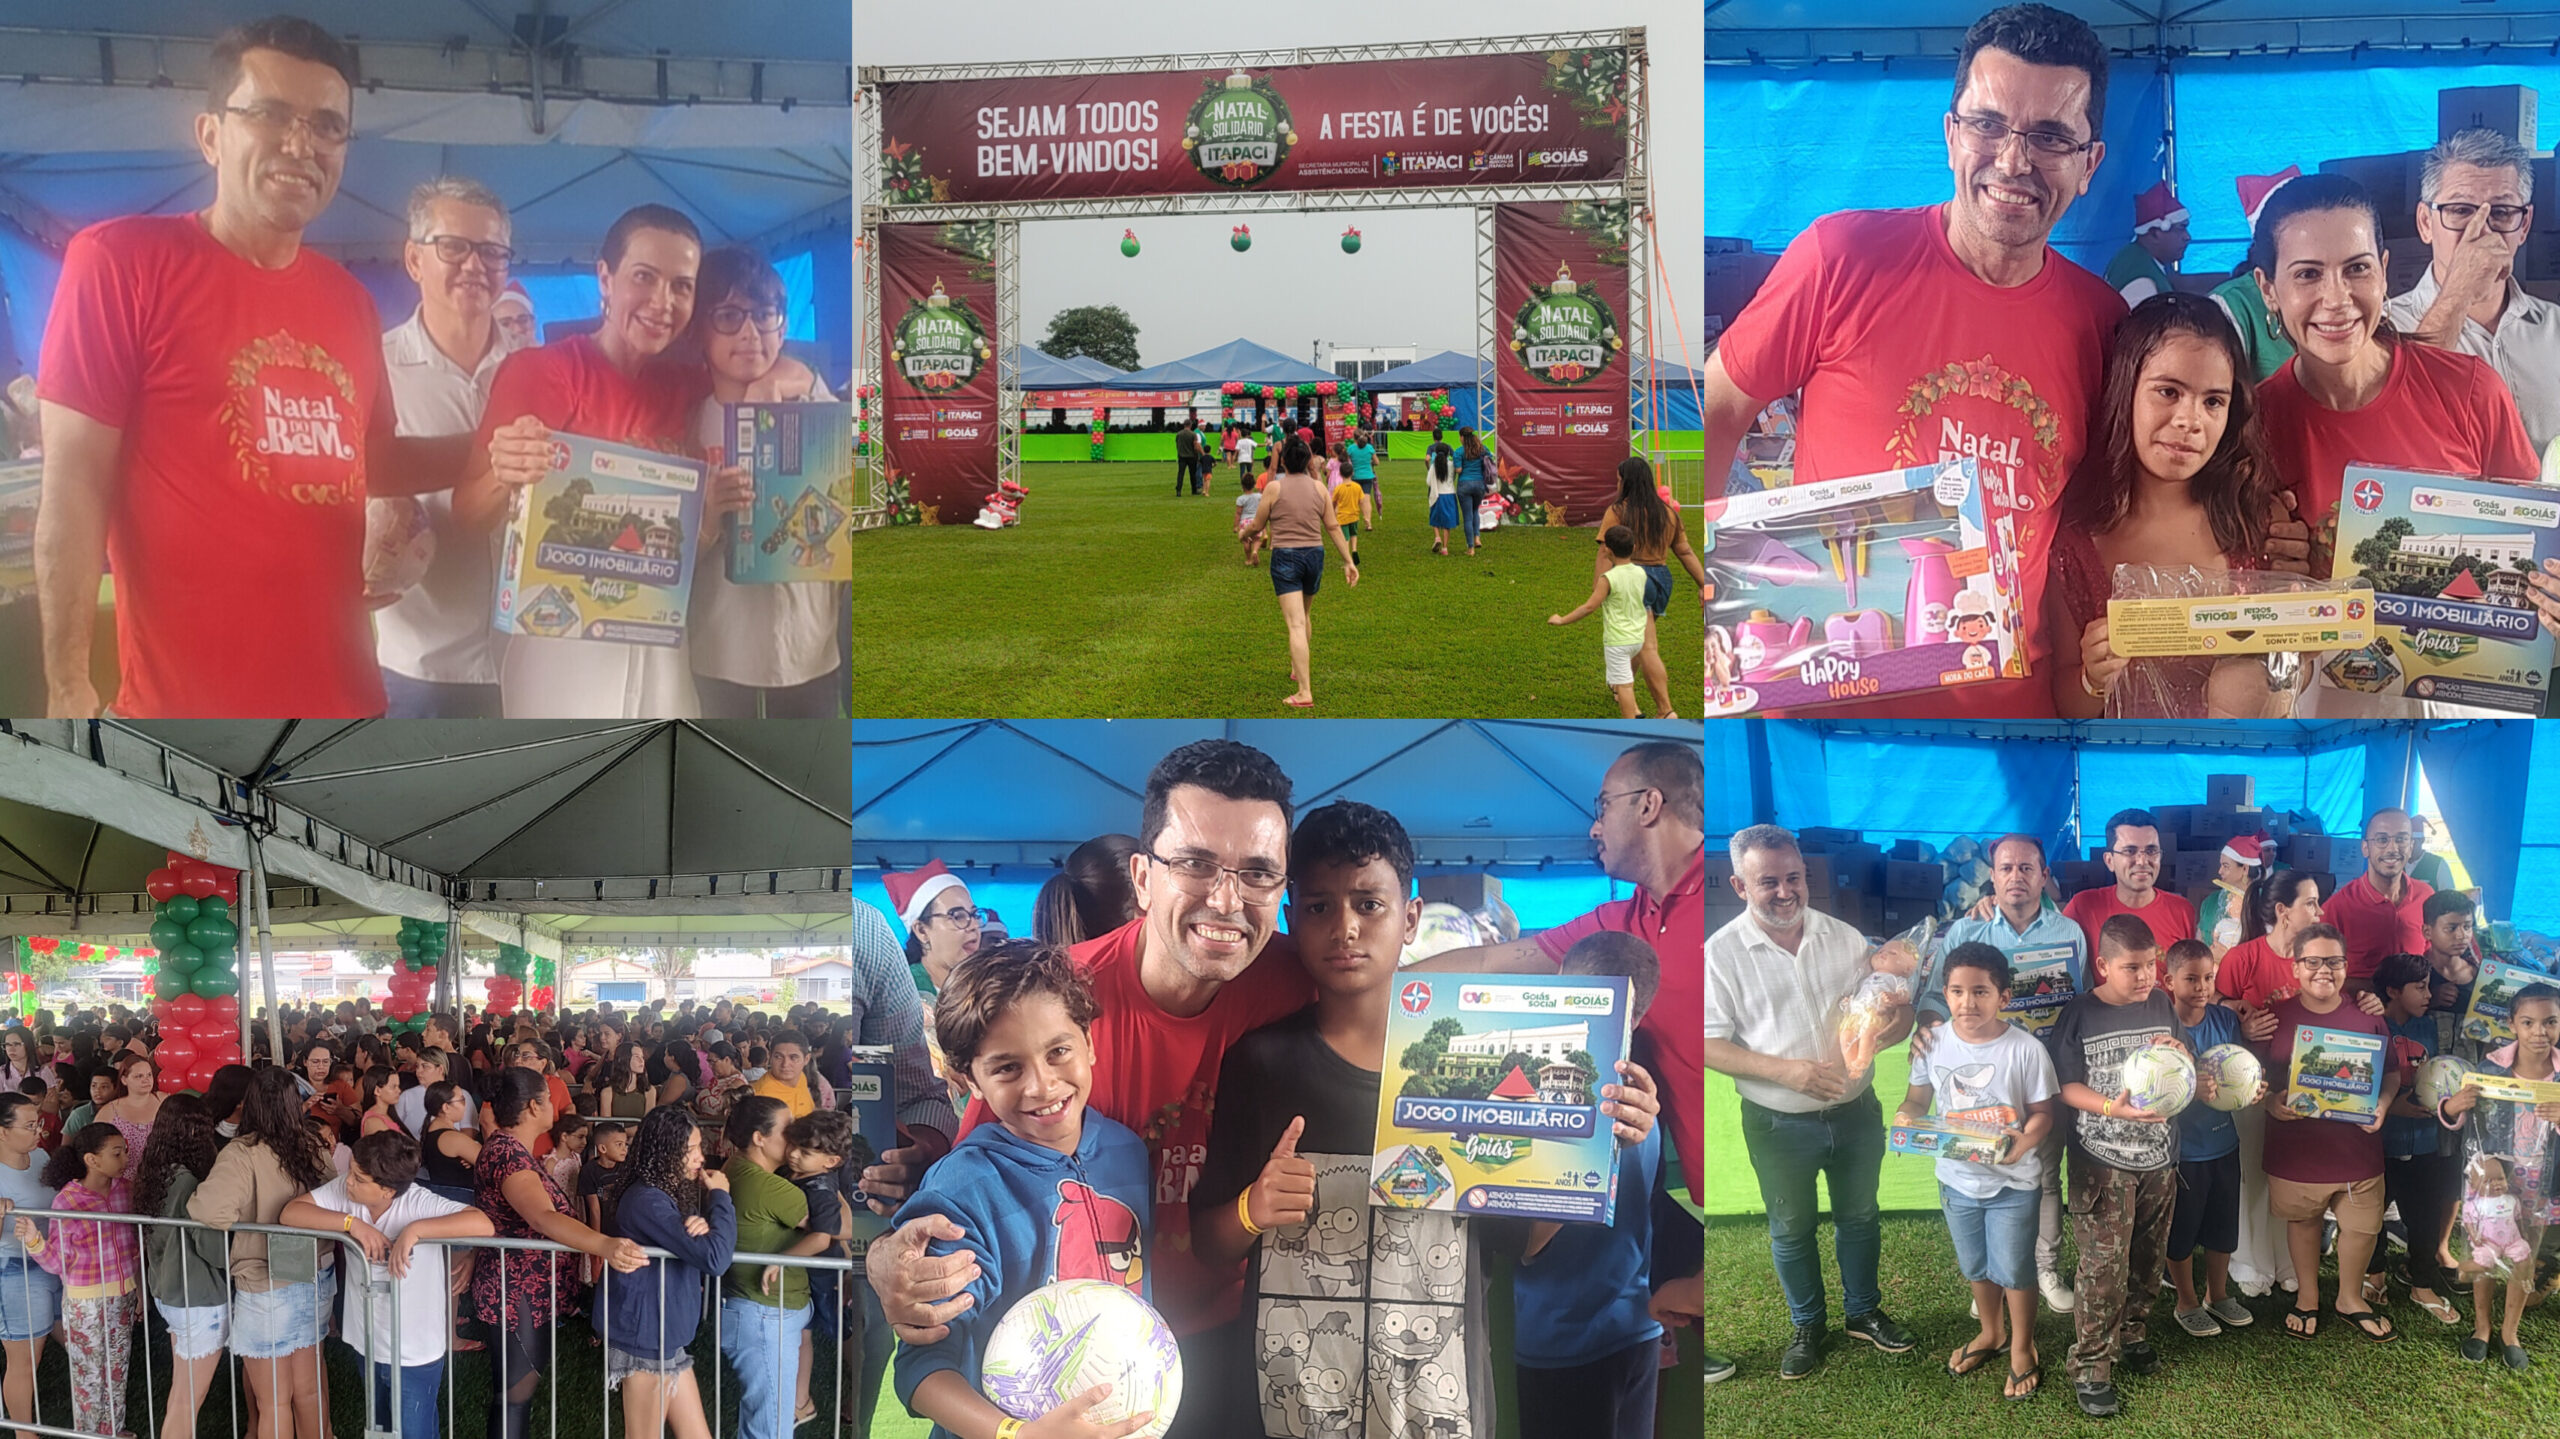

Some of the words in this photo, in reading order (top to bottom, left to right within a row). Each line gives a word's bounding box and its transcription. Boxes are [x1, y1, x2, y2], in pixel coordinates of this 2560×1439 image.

[1213, 100, 1268, 122] NATAL
[1319, 113, 1333, 140] A
[1340, 110, 1404, 139] FESTA
[1413, 102, 1427, 136] É
[1434, 107, 1462, 136] DE
[1470, 95, 1549, 134] VOCÊS!
[977, 104, 1066, 139] SEJAM
[1076, 100, 1159, 134] TODOS
[1212, 117, 1264, 138] SOLIDÁRIO
[978, 138, 1158, 177] BEM-VINDOS!
[1208, 146, 1268, 162] ITAPACI
[1402, 154, 1463, 170] ITAPACI
[1540, 147, 1589, 164] GOIÁS
[1298, 167, 1343, 176] ASSISTÊNCIA
[1344, 167, 1369, 175] SOCIAL
[1541, 305, 1593, 325] NATAL
[917, 318, 964, 336] NATAL
[1540, 323, 1589, 340] SOLIDÁRIO
[916, 335, 961, 351] SOLIDÁRIO
[1535, 349, 1594, 362] ITAPACI
[912, 359, 964, 371] ITAPACI
[263, 385, 343, 422] Natal
[1576, 405, 1613, 414] ITAPACI
[948, 411, 982, 420] ITAPACI
[945, 426, 978, 437] GOIÁS
[1574, 421, 1609, 433] GOIÁS
[1940, 416, 2024, 468] Natal
[2473, 499, 2500, 510] Goiás
[2478, 506, 2507, 517] social
[2522, 505, 2557, 520] GOIÁS
[545, 548, 586, 566] JOGO
[589, 553, 675, 577] IMOBILIÁRIO
[591, 575, 626, 601] Goiás
[2195, 612, 2229, 623] GOIÁS
[2244, 606, 2271, 616] social
[2252, 612, 2279, 622] Goiás
[2411, 600, 2530, 631] IMOBILIÁRIO
[2415, 629, 2461, 655] Goiás
[2498, 674, 2515, 683] ANOS
[1522, 991, 1550, 1001] Goiás
[1528, 999, 1557, 1008] social
[1573, 995, 1610, 1006] GOIÁS
[2301, 1076, 2322, 1085] JOGO
[2323, 1080, 2370, 1092] IMOBILIÁRIO
[1403, 1102, 1457, 1122] JOGO
[1462, 1106, 1586, 1129] IMOBILIÁRIO
[1465, 1134, 1515, 1163] Goiás
[1554, 1178, 1572, 1187] ANOS
